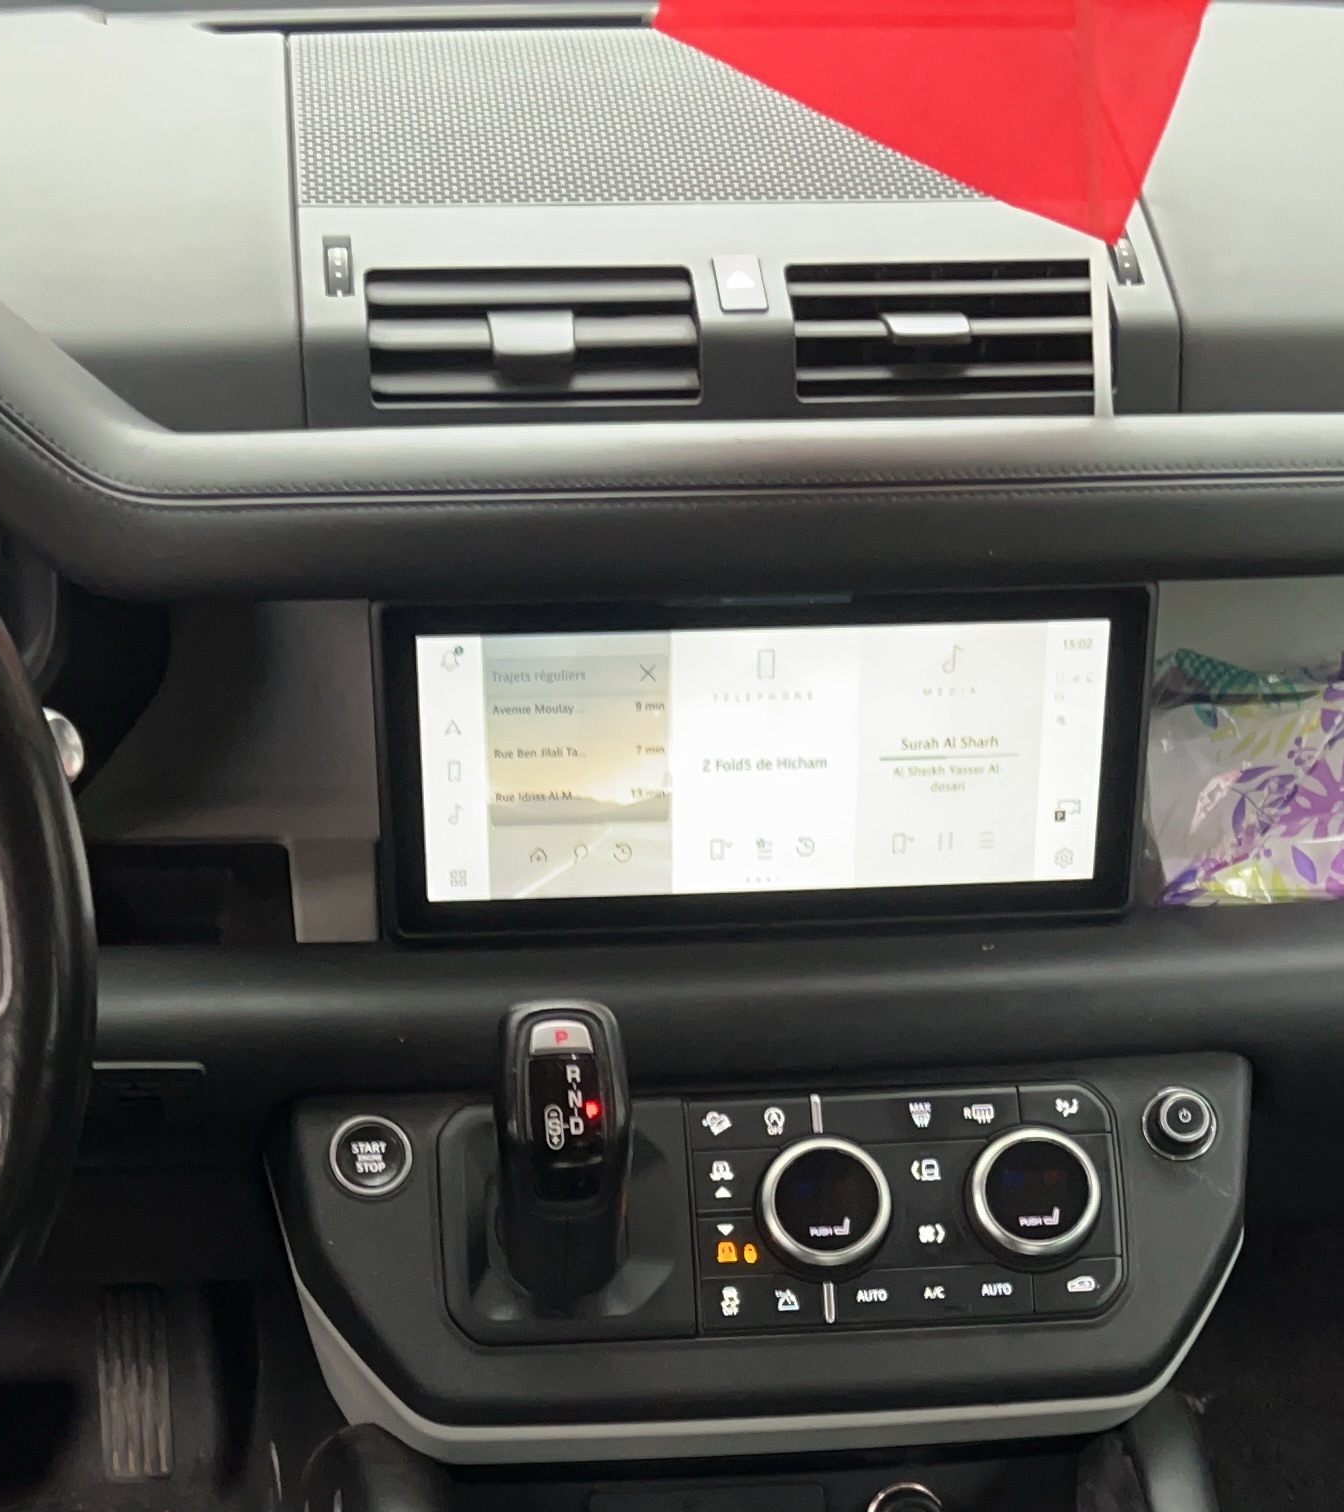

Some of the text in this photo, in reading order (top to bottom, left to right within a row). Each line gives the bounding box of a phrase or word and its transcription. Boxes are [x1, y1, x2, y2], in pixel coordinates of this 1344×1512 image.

[1063, 638, 1094, 651] 15:02
[491, 668, 586, 685] Trajets réguliers
[492, 704, 531, 715] Avenue
[534, 703, 574, 716] Moulay
[645, 700, 665, 712] min
[645, 745, 665, 755] min
[901, 735, 999, 752] Surah Al Sharh
[494, 748, 514, 760] Rue
[517, 747, 537, 759] Ben
[755, 756, 773, 771] de
[776, 755, 827, 771] Hicham
[908, 765, 945, 777] Sheikh
[495, 792, 515, 803] Rue
[518, 791, 546, 802] Idriss
[555, 1030, 568, 1044] P
[565, 1064, 581, 1083] R
[568, 1089, 583, 1108] N
[963, 1106, 972, 1120] R
[548, 1116, 584, 1136] S D
[350, 1140, 387, 1154] START
[355, 1161, 386, 1174] STOP
[856, 1288, 888, 1303] AUTO
[924, 1286, 946, 1300] A/C
[981, 1283, 1013, 1297] AUTO
